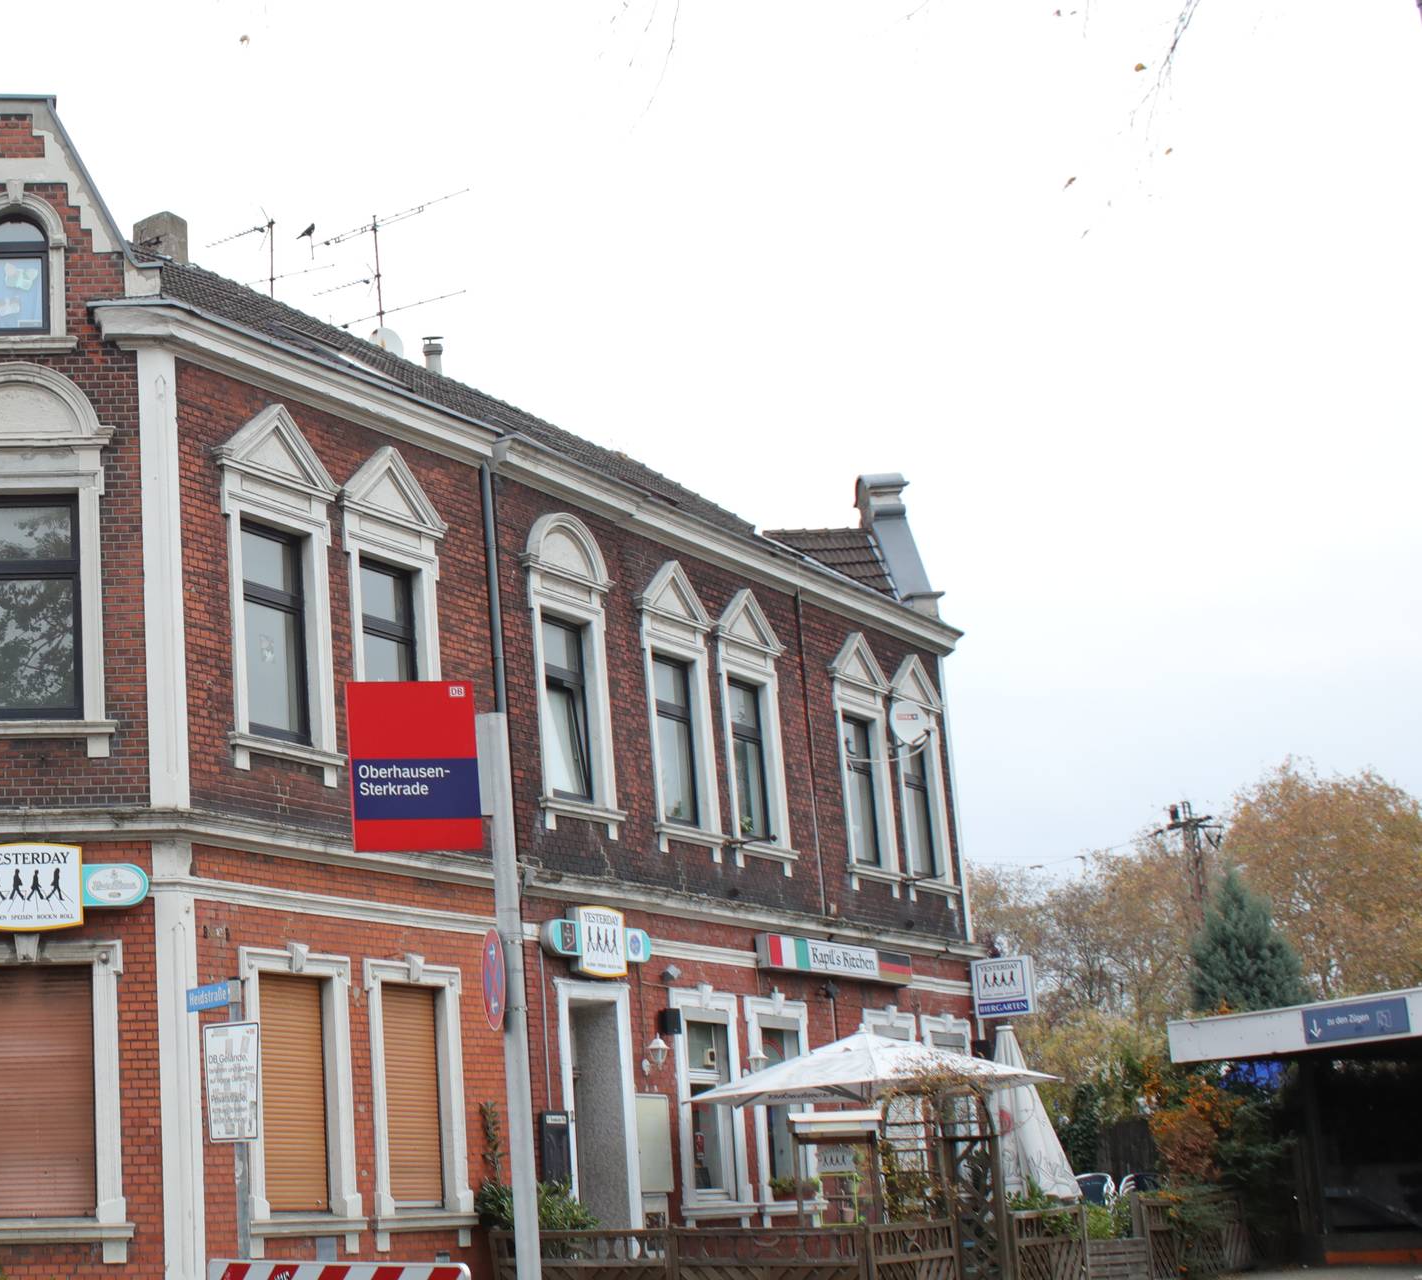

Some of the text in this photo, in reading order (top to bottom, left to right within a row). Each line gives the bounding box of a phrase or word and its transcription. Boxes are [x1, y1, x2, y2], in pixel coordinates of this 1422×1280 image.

[450, 687, 464, 697] DB
[358, 764, 451, 780] Oberhausen-
[360, 782, 429, 796] Sterkrade
[583, 911, 620, 926] YESTERDAY
[811, 946, 876, 971] Kapil's Kitchen
[979, 963, 1019, 973] YESTERDAY
[189, 987, 227, 1006] Heidstraße
[979, 1001, 1028, 1014] BIERGARTEN
